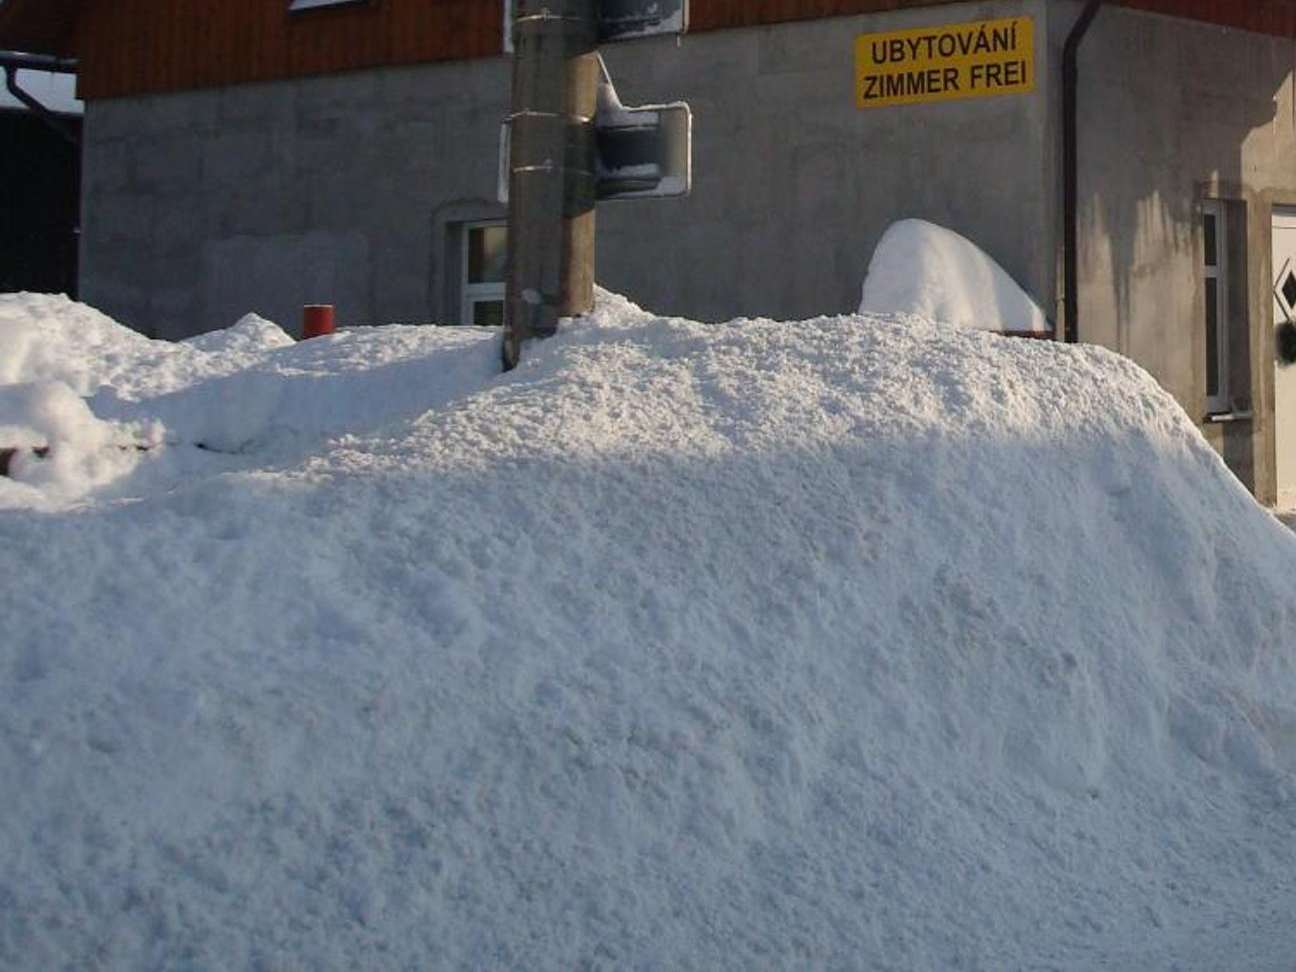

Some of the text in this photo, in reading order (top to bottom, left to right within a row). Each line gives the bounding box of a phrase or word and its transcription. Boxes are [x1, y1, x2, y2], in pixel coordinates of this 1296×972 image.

[871, 21, 1018, 64] UBYTOVÁNÍ
[863, 60, 1026, 99] ZIMMER FREI
